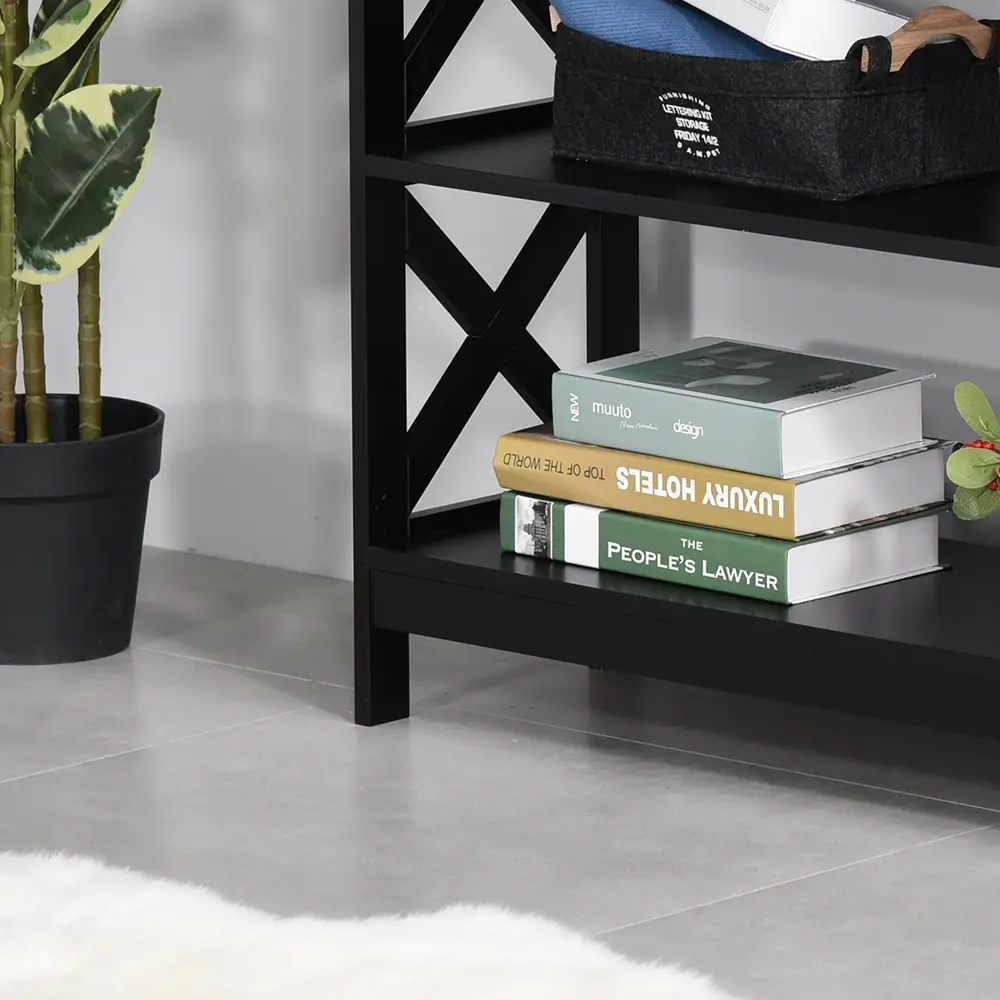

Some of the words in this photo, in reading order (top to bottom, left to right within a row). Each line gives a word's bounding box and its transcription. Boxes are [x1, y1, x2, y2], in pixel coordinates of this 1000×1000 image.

[661, 103, 702, 119] LETTERING
[675, 117, 710, 132] STORAGE
[673, 129, 700, 143] FRIDAY
[569, 392, 579, 422] NEW
[592, 401, 632, 419] muuto
[673, 419, 704, 440] design
[503, 452, 541, 470] WORLD
[544, 458, 564, 474] THE
[566, 463, 581, 476] OF
[583, 466, 605, 480] TOP
[616, 466, 696, 503] HOTELS
[702, 481, 785, 519] LUXURY
[680, 537, 704, 551] THE
[607, 541, 696, 574] PEOPLE'S
[702, 559, 779, 591] LAWYER
